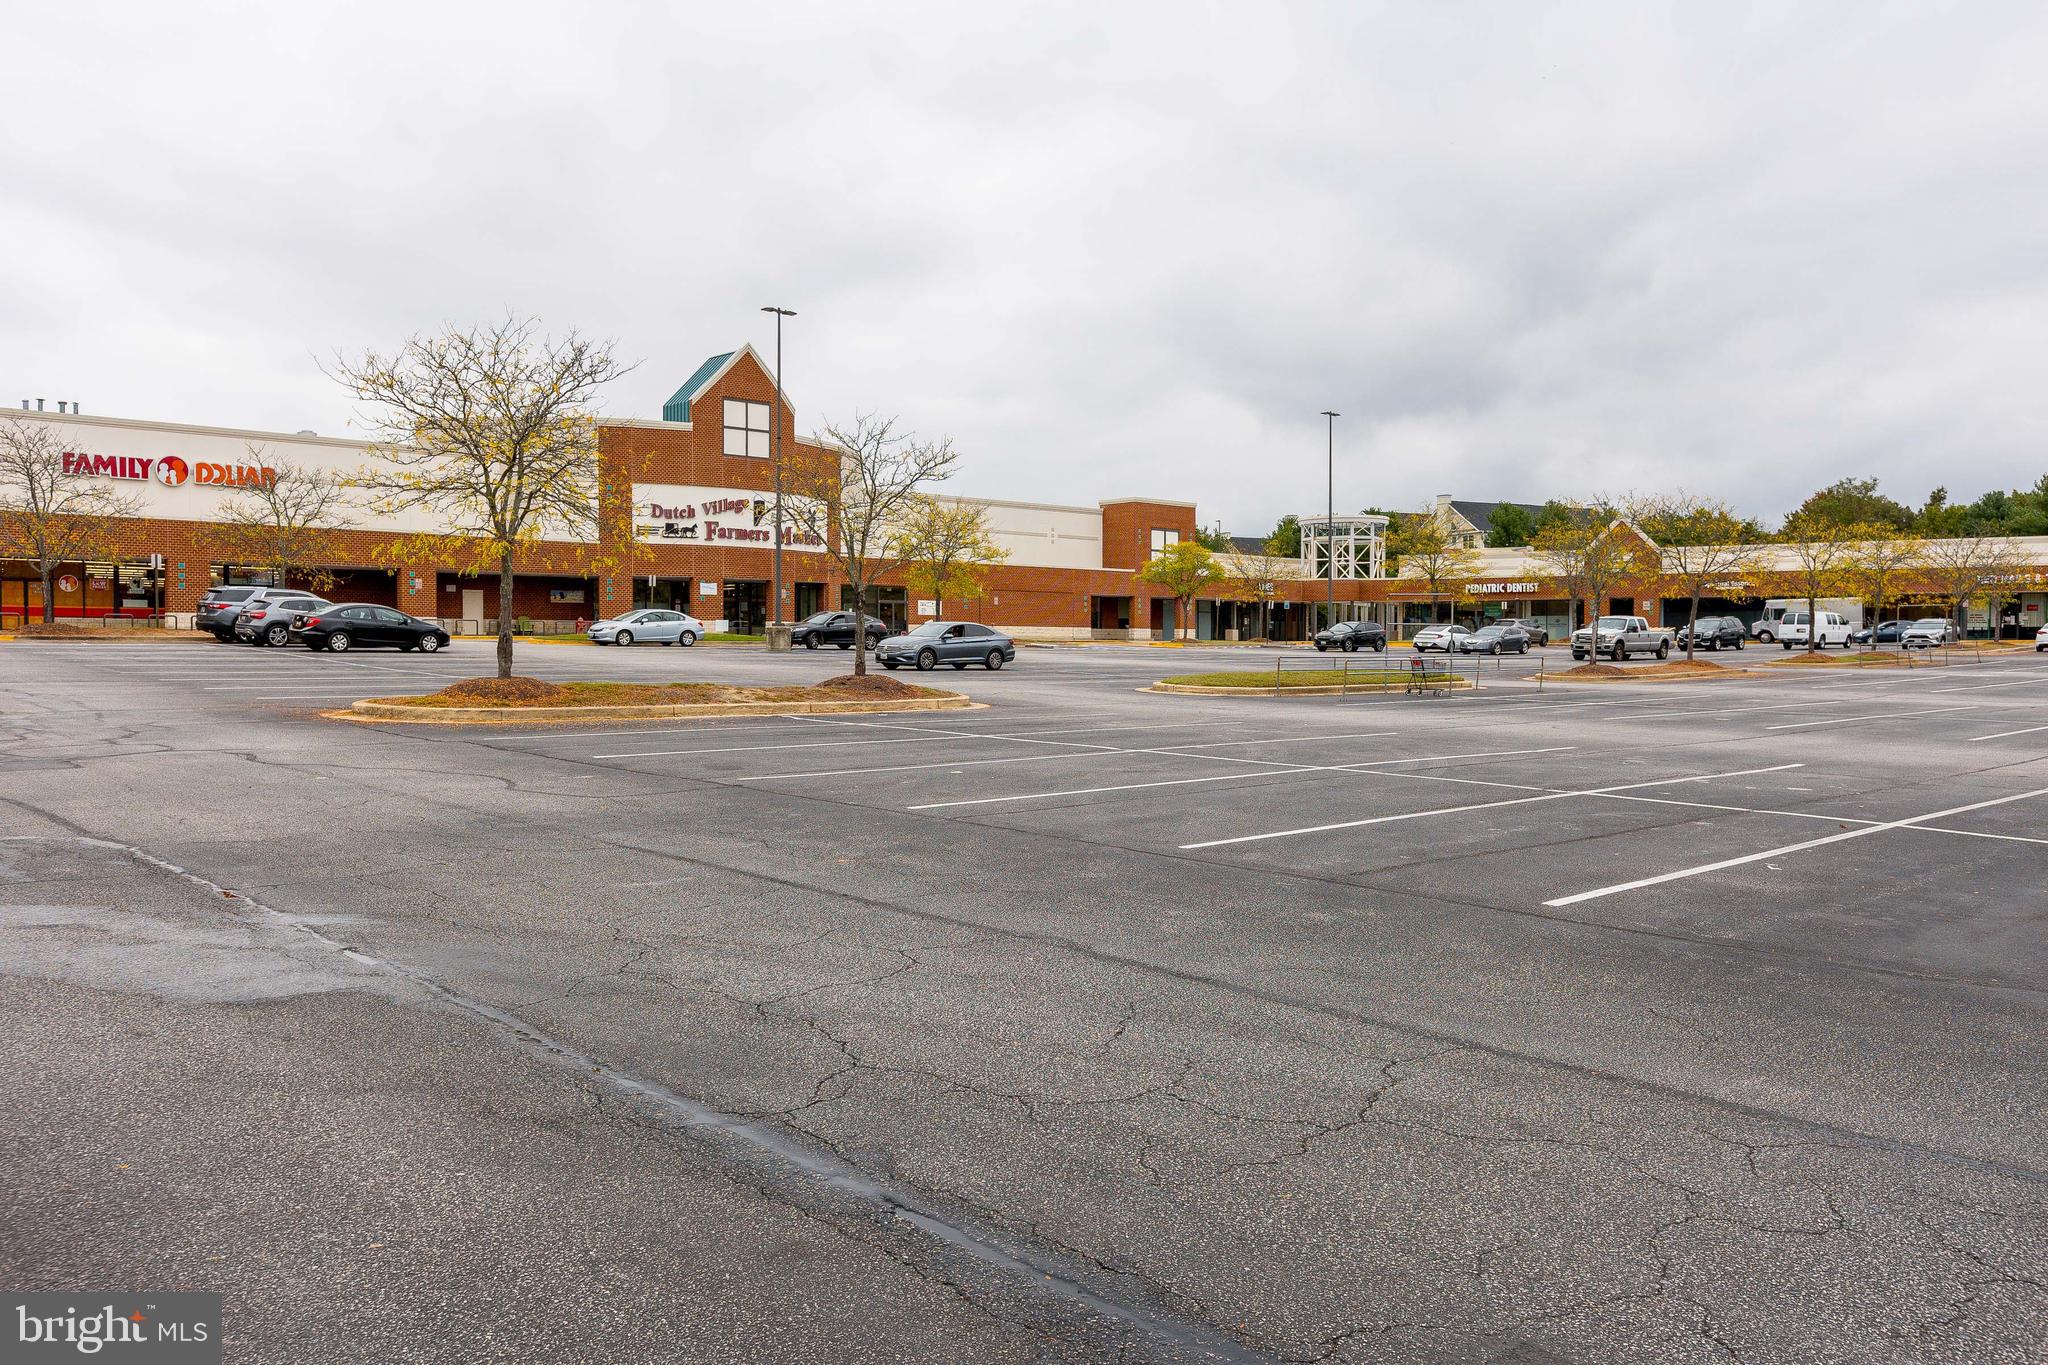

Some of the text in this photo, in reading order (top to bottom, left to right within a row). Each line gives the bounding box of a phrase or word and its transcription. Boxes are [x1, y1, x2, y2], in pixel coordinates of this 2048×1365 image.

[62, 452, 276, 488] FAMILY DOLLAR
[650, 499, 750, 520] Dutch Villag
[704, 521, 770, 542] Farmers
[1465, 582, 1539, 593] PEDIATRIC DENTIST
